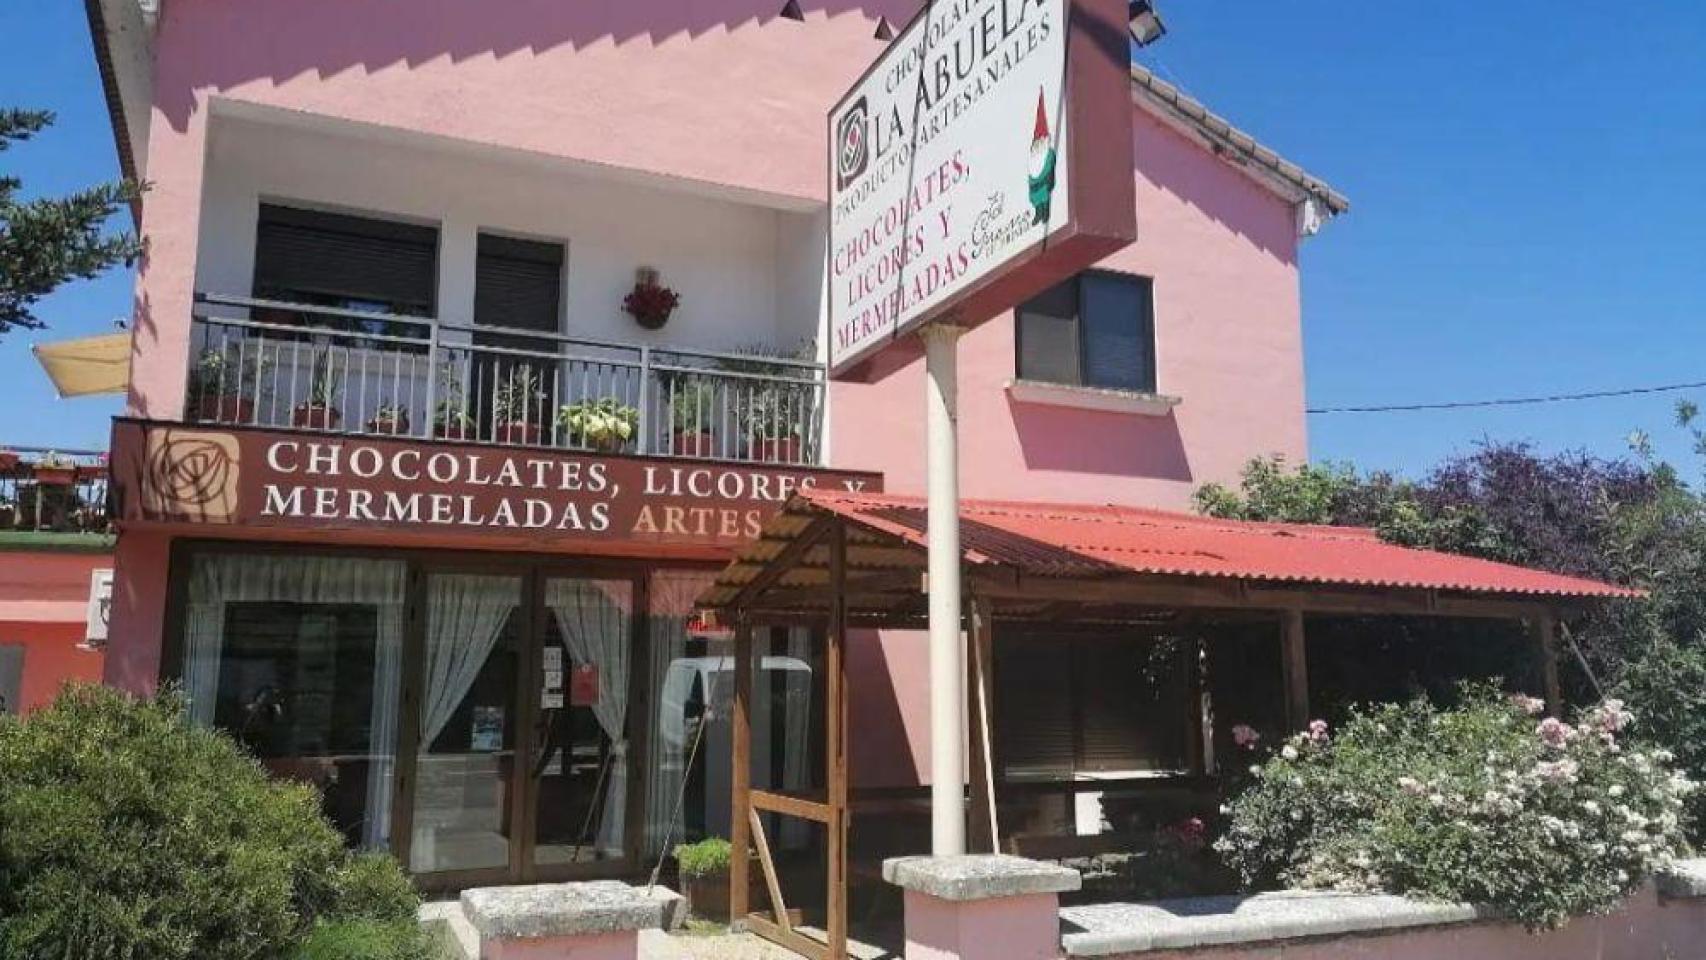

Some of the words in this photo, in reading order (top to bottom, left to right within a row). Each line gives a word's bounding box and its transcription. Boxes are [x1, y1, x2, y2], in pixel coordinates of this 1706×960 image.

[920, 12, 1050, 145] ARTESANALES
[875, 103, 904, 159] LA
[834, 150, 970, 277] CHOCOLATES,
[848, 224, 924, 307] LICORES
[939, 205, 951, 239] Y
[837, 241, 968, 349] MERMELADAS
[260, 484, 610, 531] MERMELADAS
[267, 441, 620, 498] CHOCOLATES,
